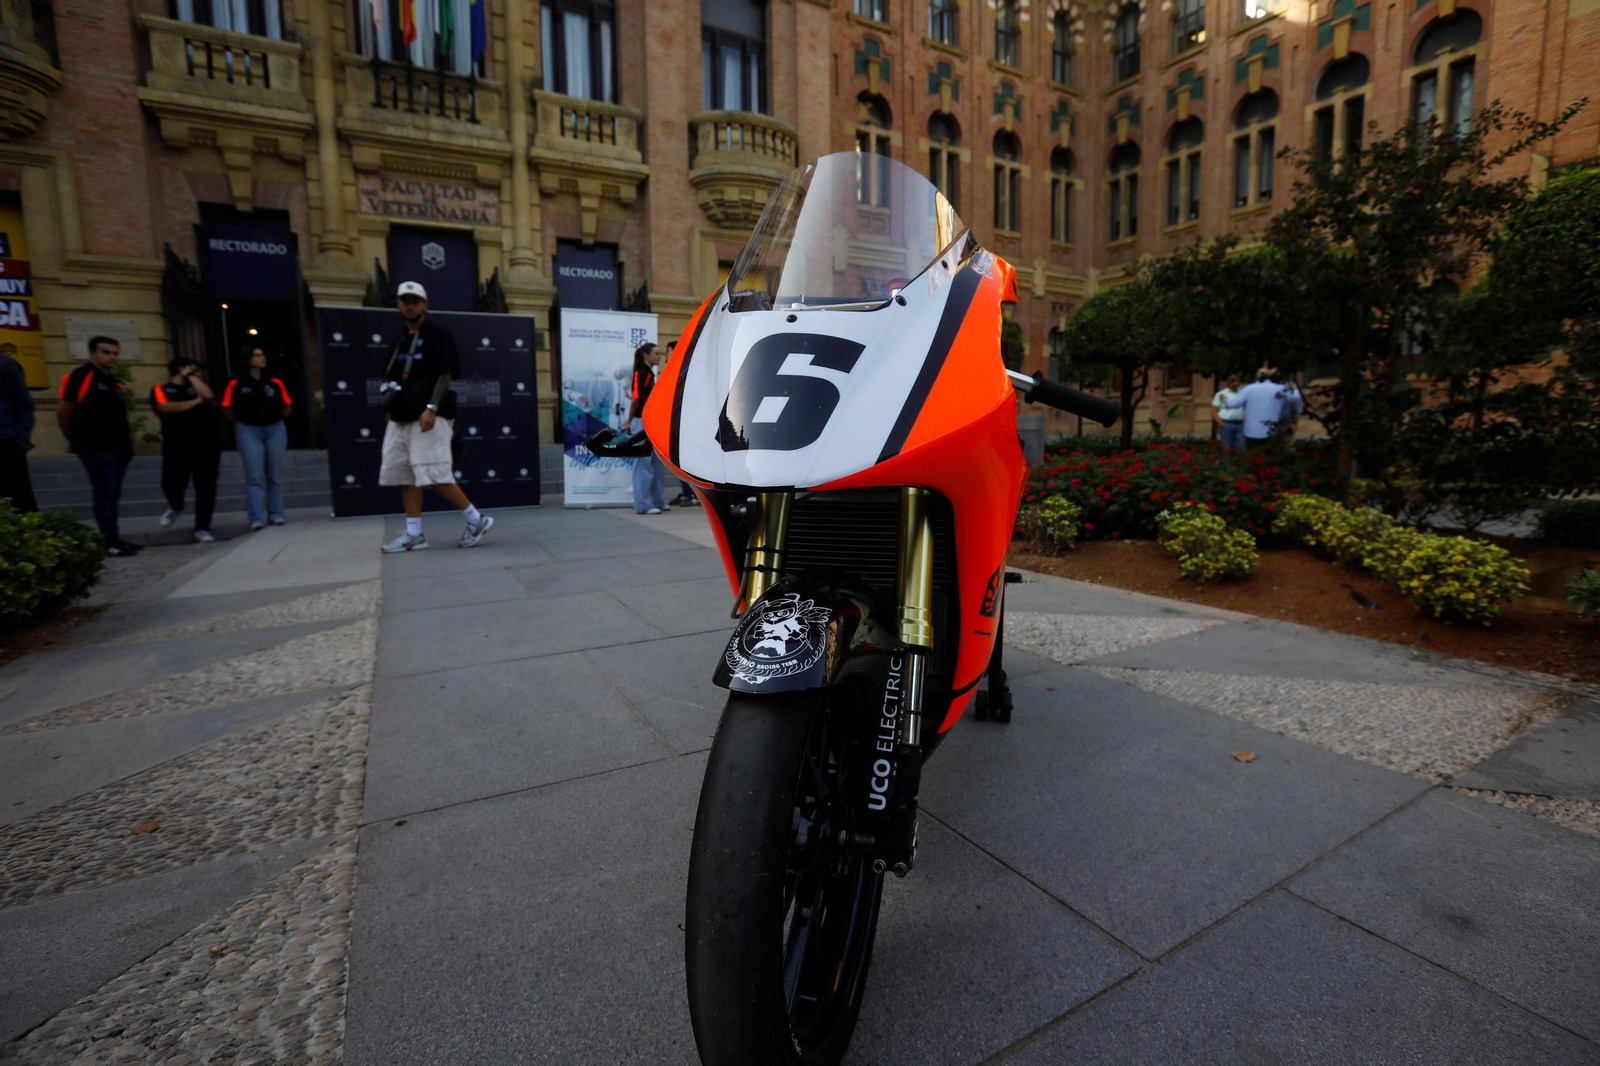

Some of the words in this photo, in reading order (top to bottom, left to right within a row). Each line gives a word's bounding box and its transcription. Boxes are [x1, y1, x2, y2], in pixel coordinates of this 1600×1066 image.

[367, 198, 490, 224] VETERINARIA
[209, 238, 287, 255] RECTORADO
[559, 266, 613, 279] RECTORADO
[631, 328, 647, 338] EP
[715, 333, 866, 452] 6
[781, 659, 798, 668] TEAM
[876, 656, 902, 752] ELECTRIC
[868, 758, 891, 811] UCO
